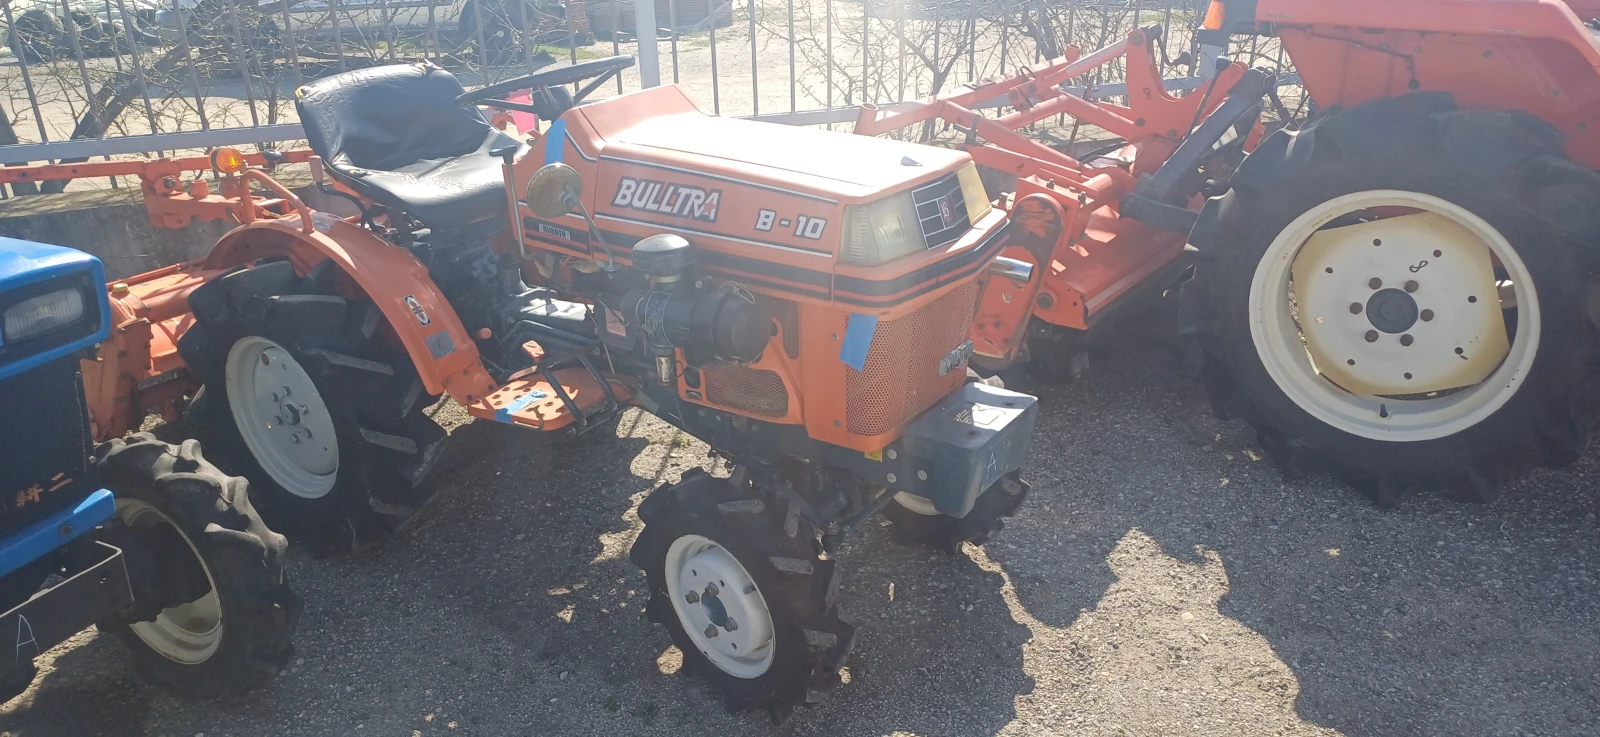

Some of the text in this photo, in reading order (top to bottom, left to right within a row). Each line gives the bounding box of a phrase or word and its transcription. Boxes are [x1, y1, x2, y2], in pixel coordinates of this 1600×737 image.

[613, 178, 720, 221] BULLTRA
[756, 210, 776, 231] B
[795, 216, 826, 239] 10
[986, 452, 998, 480] A
[15, 614, 41, 663] A
